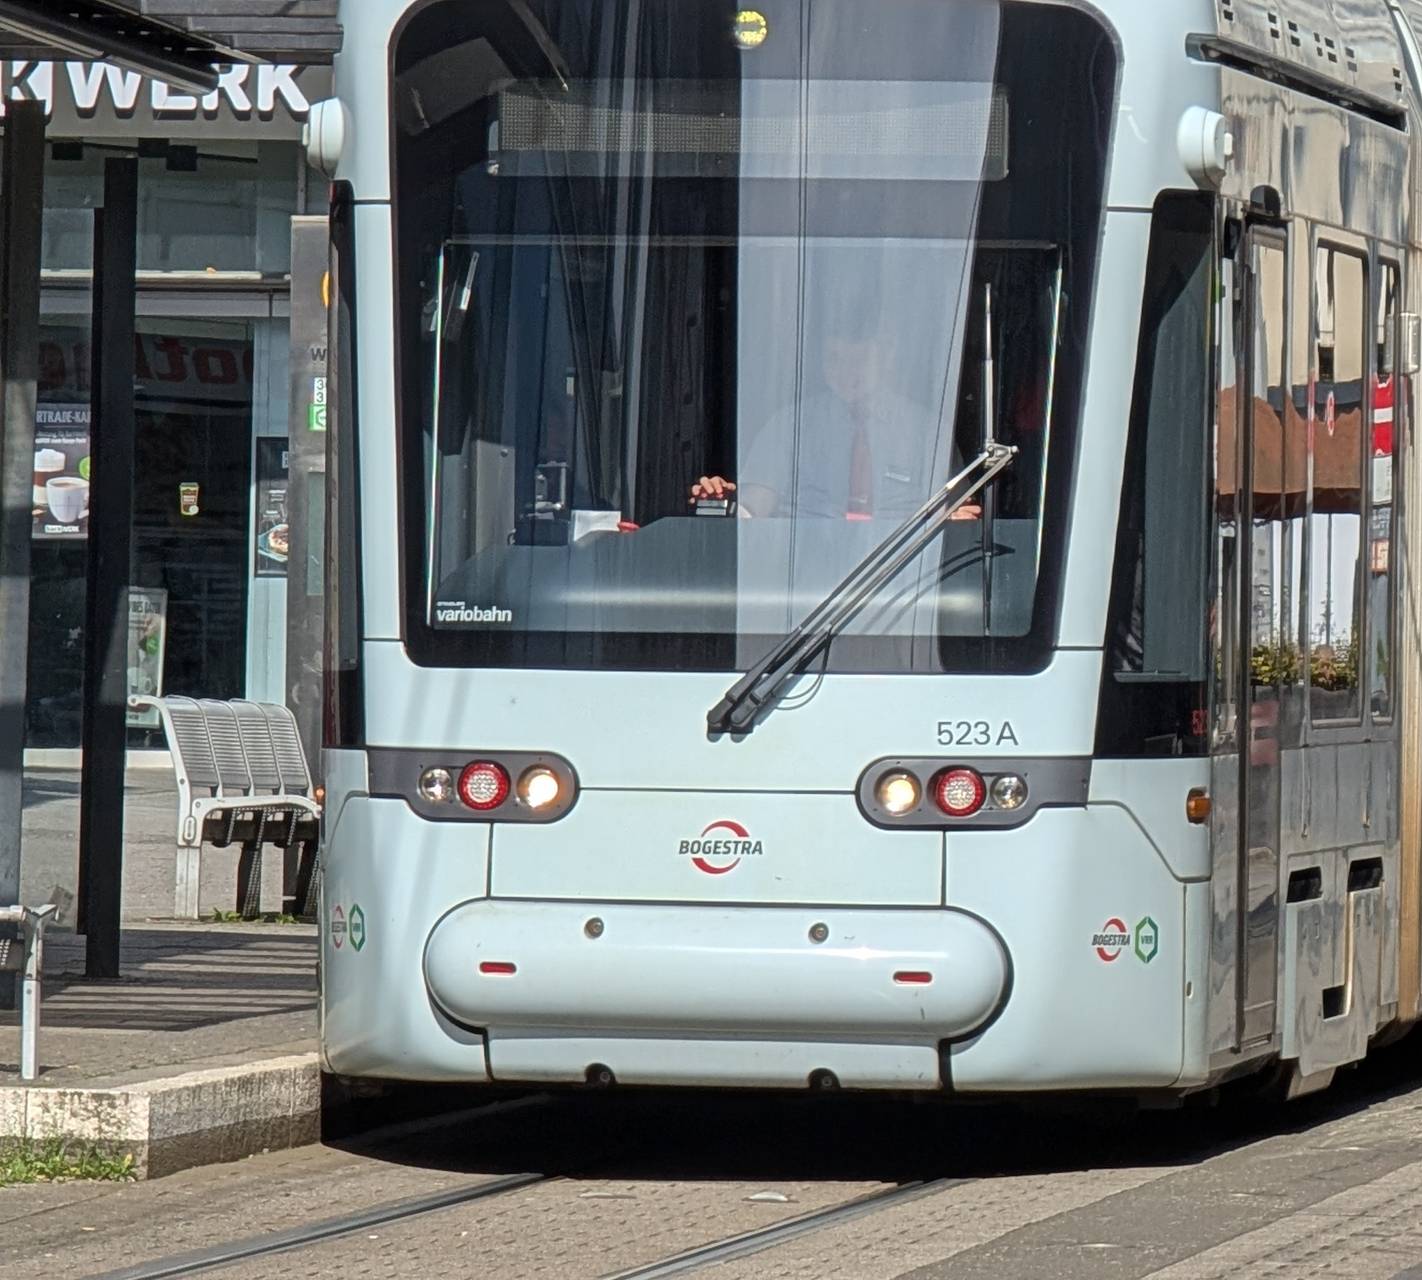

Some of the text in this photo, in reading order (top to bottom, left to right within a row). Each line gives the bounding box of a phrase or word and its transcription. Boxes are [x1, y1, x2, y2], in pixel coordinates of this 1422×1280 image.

[436, 606, 512, 622] variobahn
[937, 721, 1019, 746] 523 A
[679, 840, 763, 855] BOGESTRA
[1092, 934, 1131, 946] BOGESTRA
